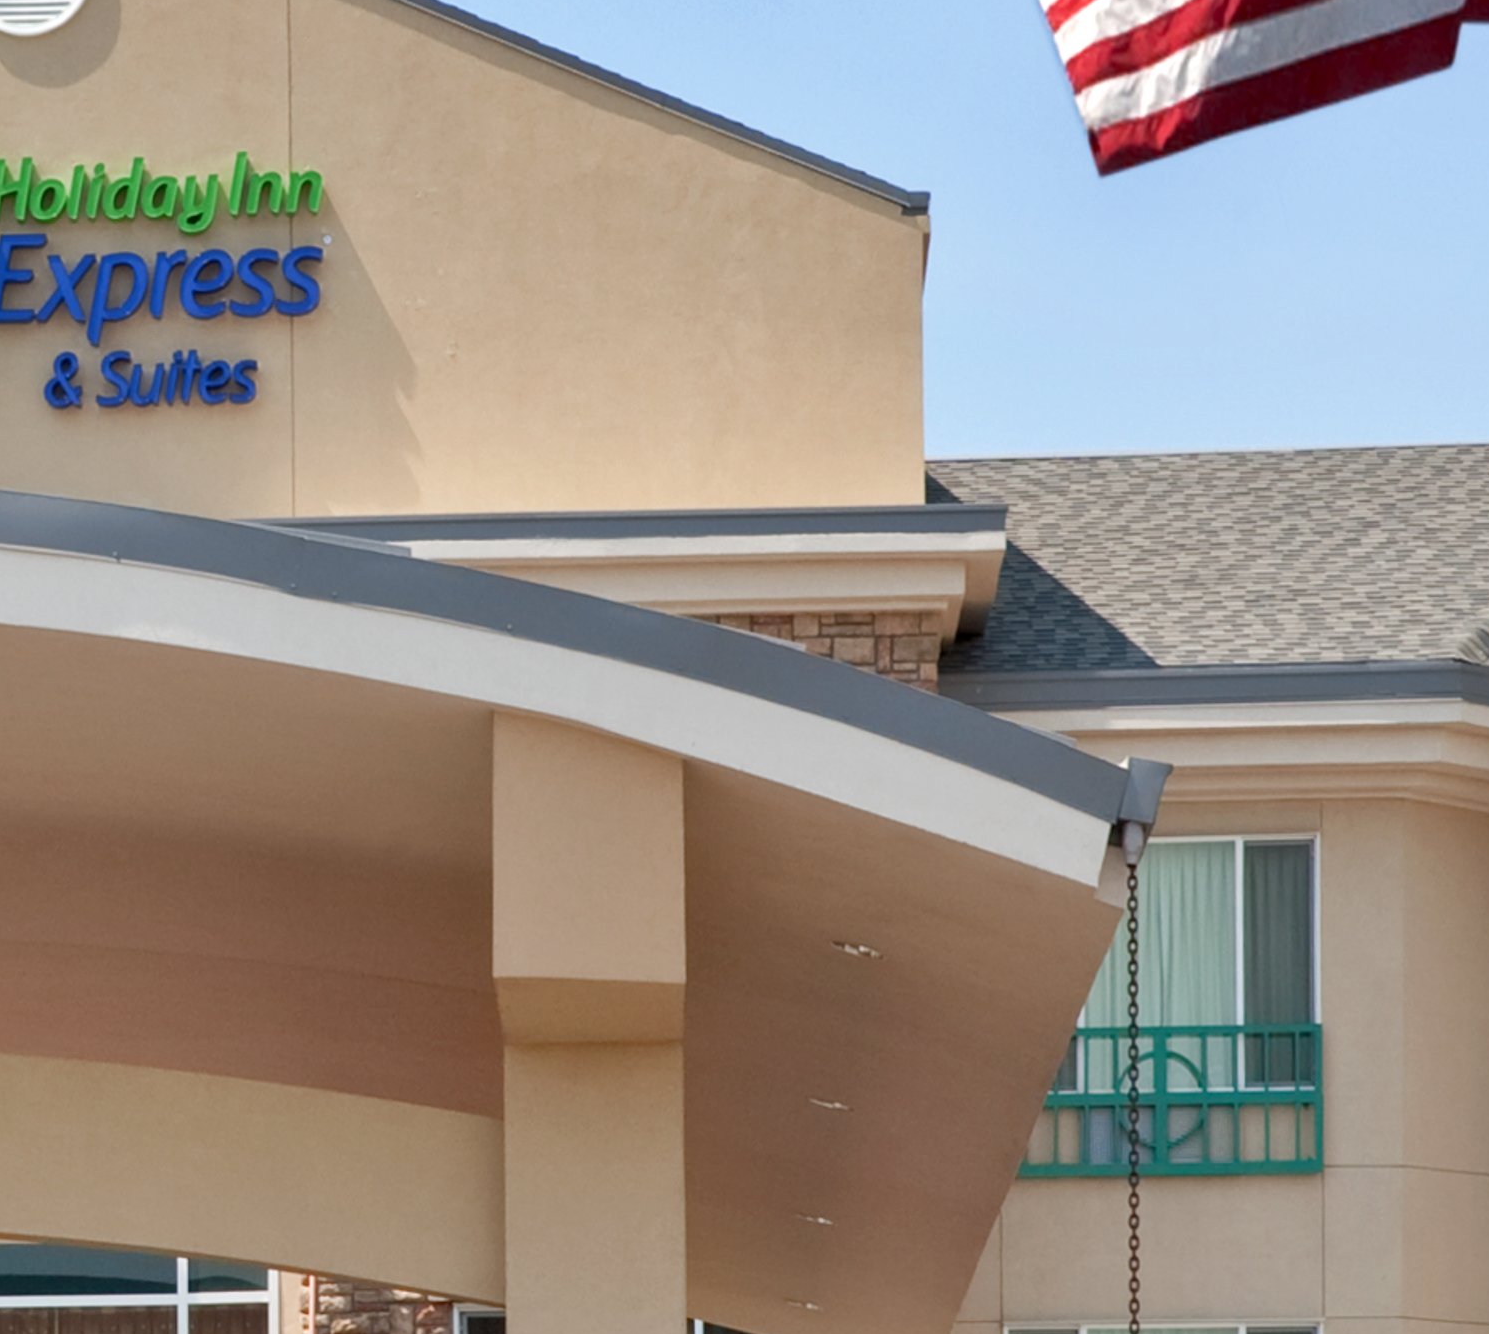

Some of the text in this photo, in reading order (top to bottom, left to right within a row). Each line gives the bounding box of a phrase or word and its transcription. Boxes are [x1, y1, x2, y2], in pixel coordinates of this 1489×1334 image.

[229, 151, 323, 217] Inn
[43, 349, 259, 410] & Suites
